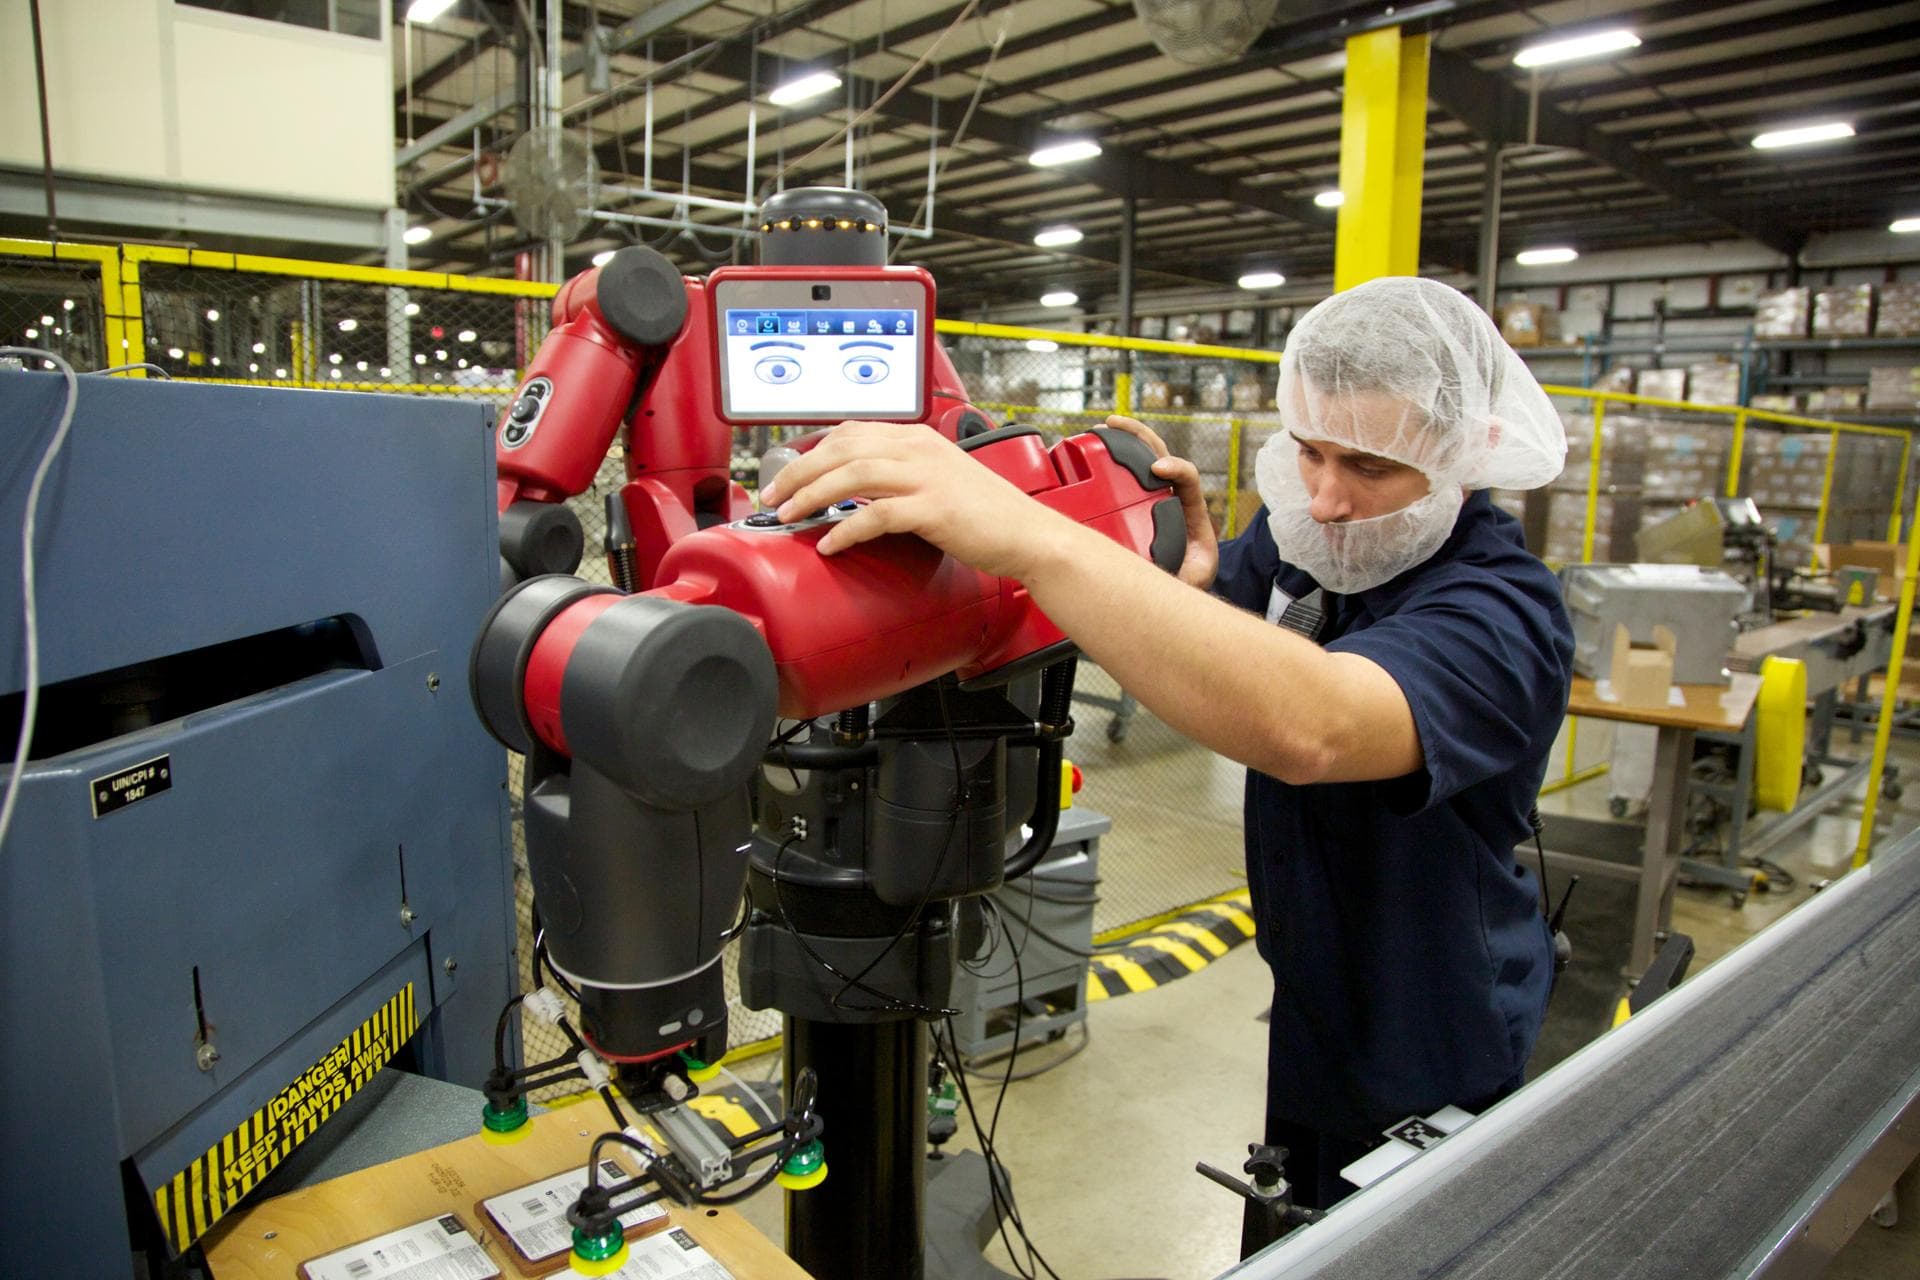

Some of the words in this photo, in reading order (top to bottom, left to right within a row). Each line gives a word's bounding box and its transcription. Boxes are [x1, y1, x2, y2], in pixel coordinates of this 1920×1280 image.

[125, 785, 146, 802] 1847
[223, 1131, 278, 1187] KEEP
[282, 1072, 346, 1136] HANDS
[351, 1032, 388, 1080] AWAY
[272, 1048, 348, 1120] DANGER
